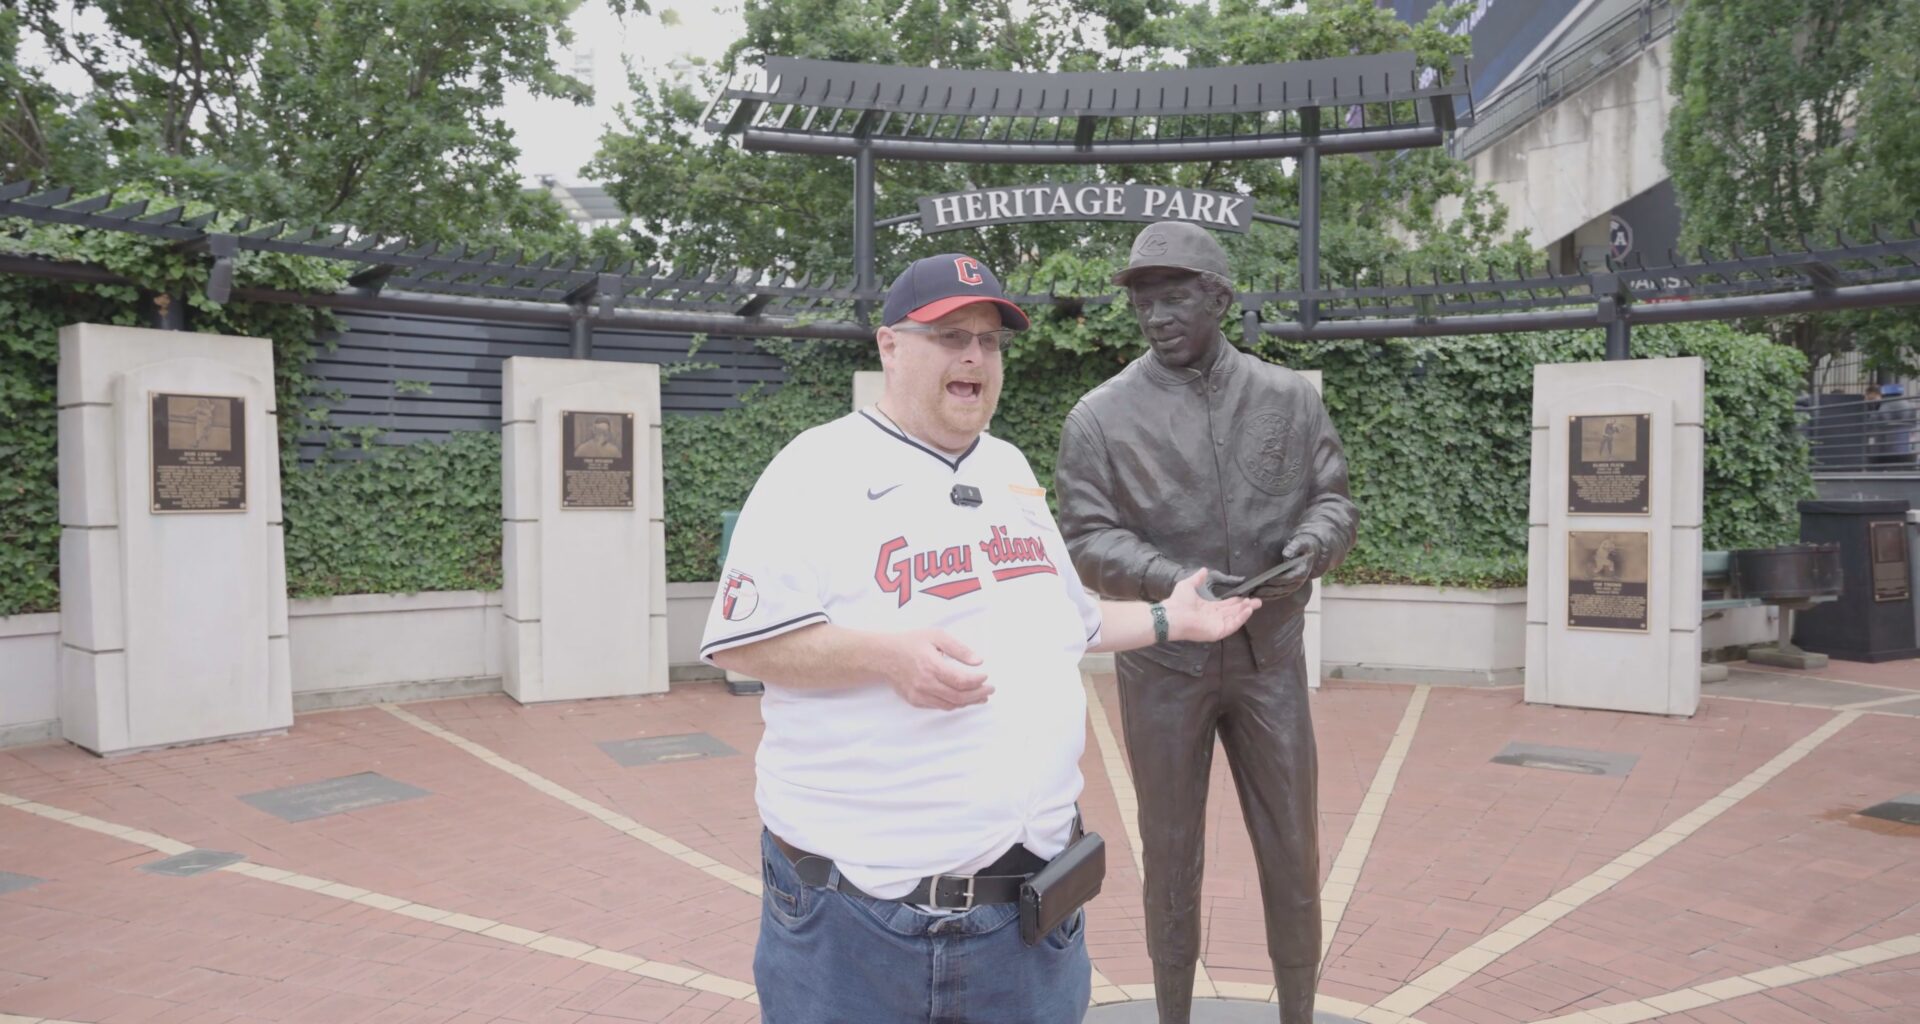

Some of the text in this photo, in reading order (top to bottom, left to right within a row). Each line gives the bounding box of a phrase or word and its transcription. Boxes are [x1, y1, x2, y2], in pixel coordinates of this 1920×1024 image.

[931, 186, 1244, 227] HERITAGE PARK
[954, 256, 983, 286] C
